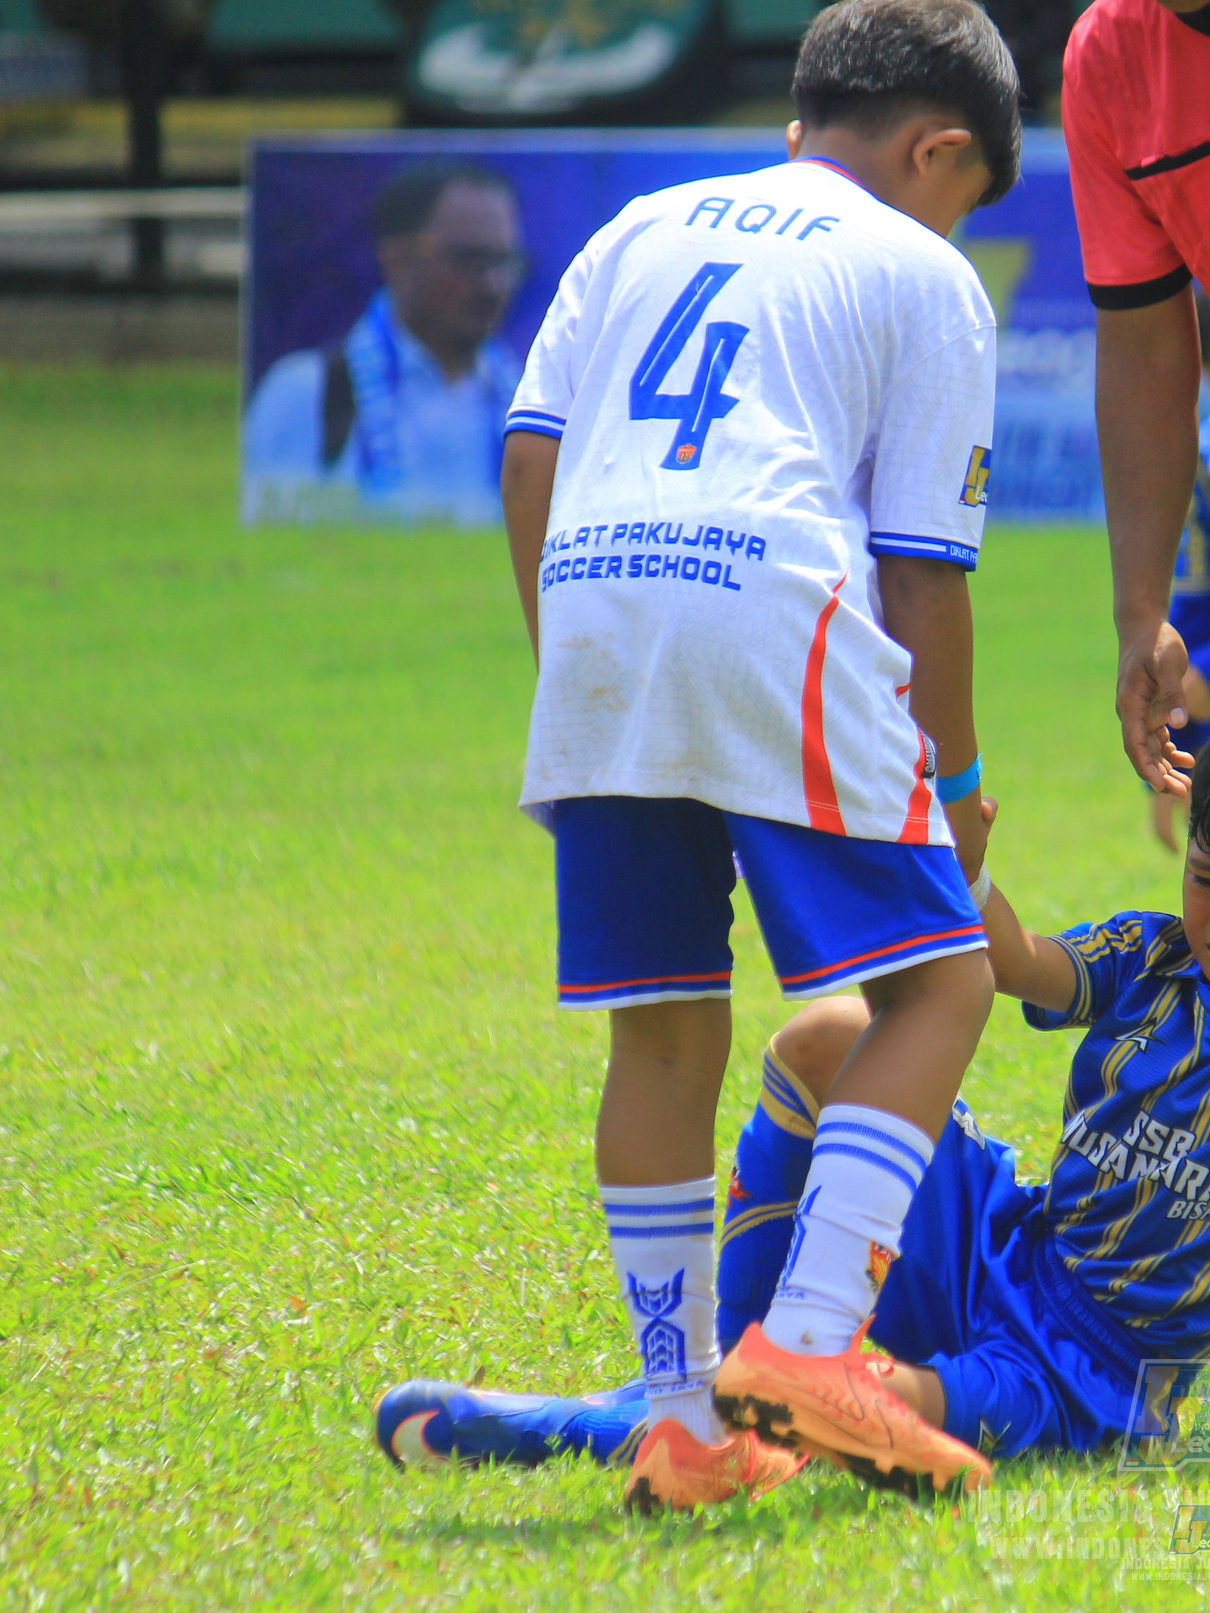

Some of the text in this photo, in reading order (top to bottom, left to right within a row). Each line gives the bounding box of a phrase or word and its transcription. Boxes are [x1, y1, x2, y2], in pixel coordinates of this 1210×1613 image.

[684, 196, 841, 241] AQIF
[629, 261, 750, 471] 4
[610, 521, 767, 562] PAKUJAYA
[541, 553, 742, 593] SOCCER SCHOOL
[1122, 1110, 1197, 1162] SSB
